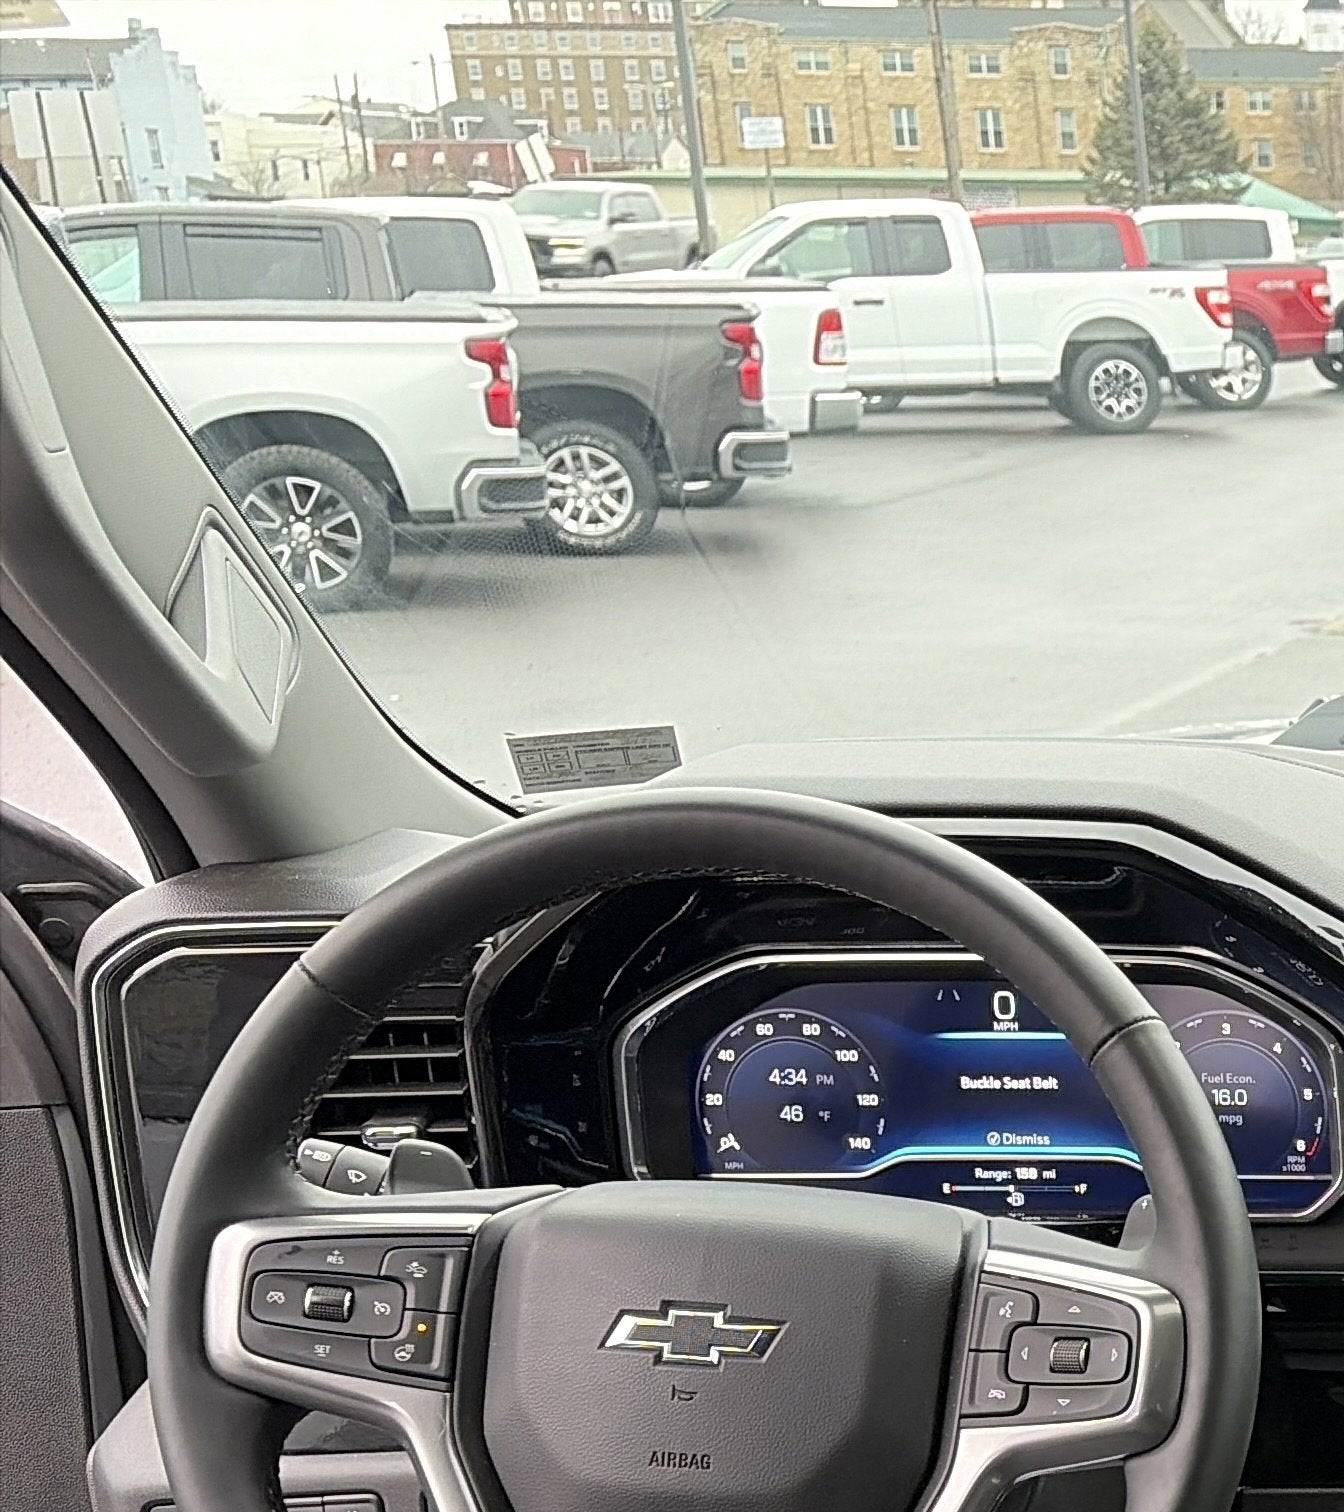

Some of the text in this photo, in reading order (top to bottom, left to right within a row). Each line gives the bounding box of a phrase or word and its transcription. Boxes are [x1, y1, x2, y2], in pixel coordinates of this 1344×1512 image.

[993, 990, 1016, 1020] 0
[756, 1024, 773, 1035] 60
[803, 1024, 820, 1035] 80
[993, 1021, 1019, 1031] MPH
[1221, 1023, 1231, 1035] 3
[1273, 1043, 1283, 1054] 4
[718, 1050, 735, 1061] 40
[835, 1050, 859, 1061] 100
[768, 1069, 834, 1085] 4:34 PM
[960, 1076, 1059, 1089] Buckle Seat Belt
[1201, 1073, 1256, 1083] Fuel Econ.
[706, 1095, 722, 1105] 20
[856, 1094, 879, 1105] 120
[1211, 1089, 1248, 1106] 16.0
[1304, 1089, 1313, 1100] 5
[780, 1106, 804, 1122] 46
[1218, 1114, 1243, 1126] mpg
[848, 1137, 871, 1149] 140
[1002, 1132, 1051, 1145] Dismiss
[1296, 1140, 1306, 1151] 6
[1287, 1156, 1306, 1164] RPM
[724, 1162, 744, 1170] MPH
[974, 1168, 1012, 1182] Range:
[1042, 1169, 1057, 1180] mi
[326, 1254, 344, 1265] RES
[314, 1344, 330, 1354] SET
[648, 1450, 712, 1470] AIRBAG
